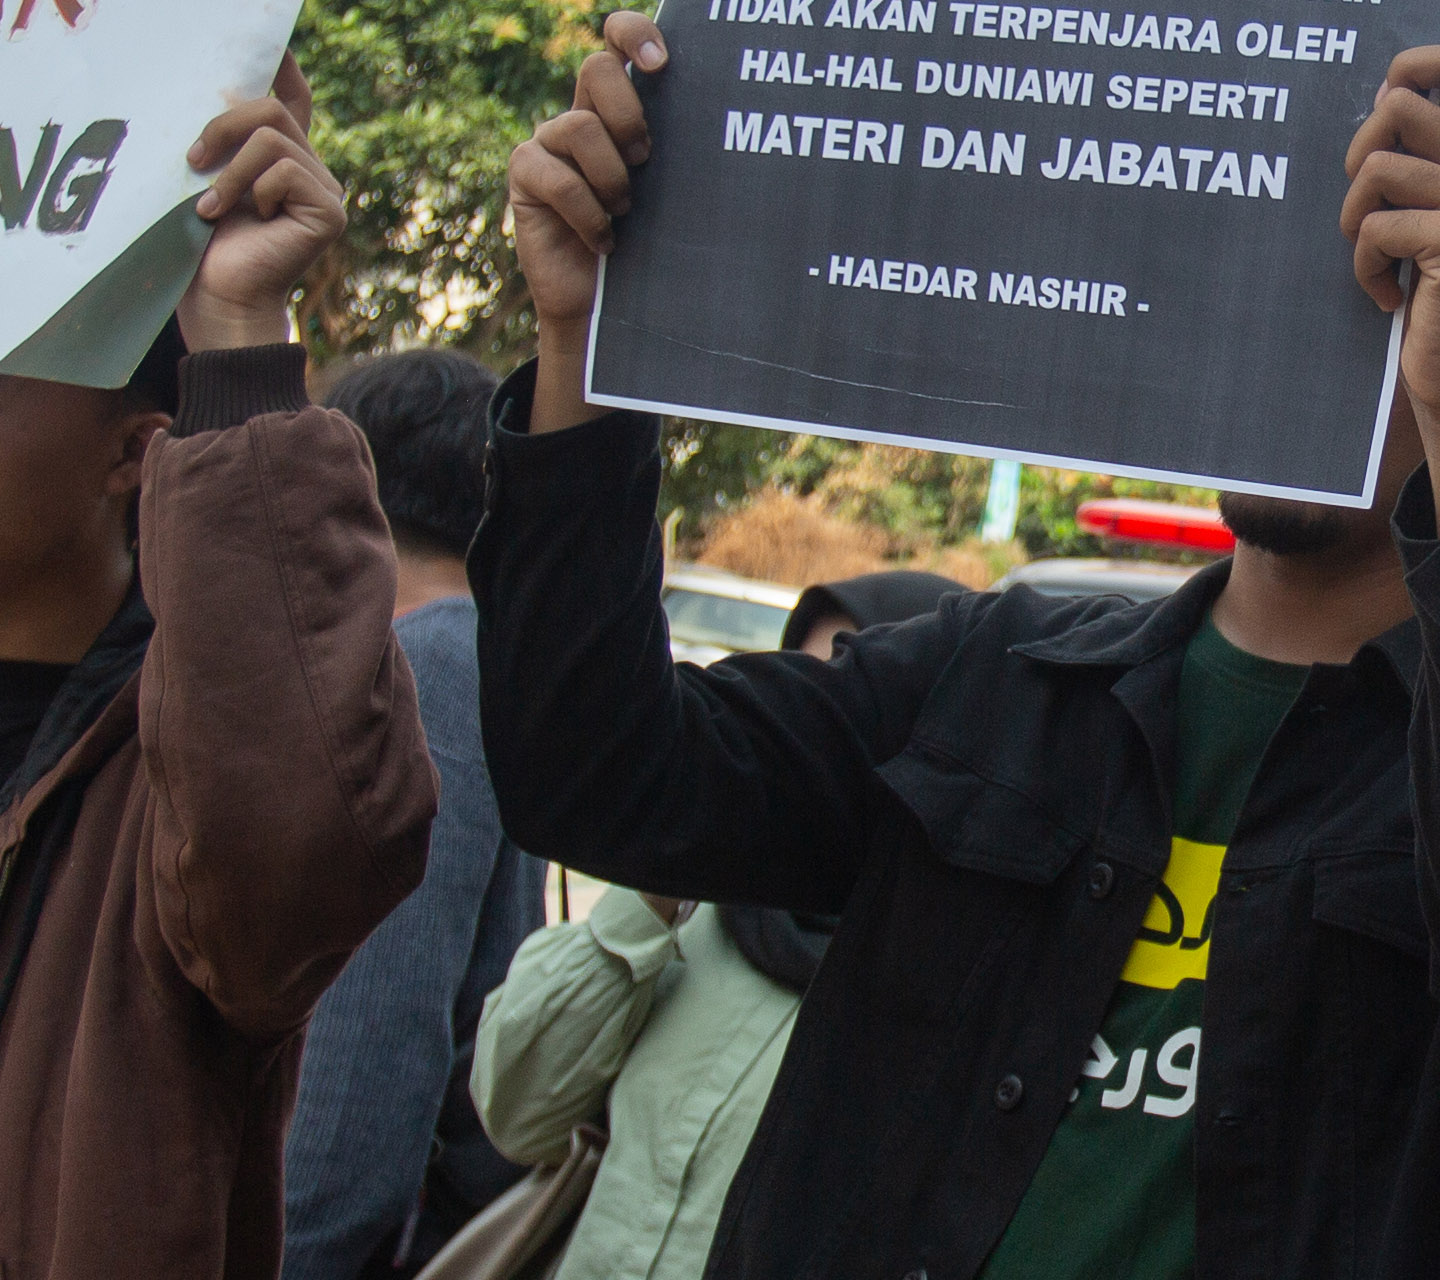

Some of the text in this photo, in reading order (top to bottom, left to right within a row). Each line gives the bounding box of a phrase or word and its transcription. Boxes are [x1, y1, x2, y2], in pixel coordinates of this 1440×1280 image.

[950, 3, 1221, 53] TERPENJARA
[1237, 23, 1357, 63] OLEH
[740, 49, 1289, 122] HAL-HAL DUNIAWI SEPERTI
[724, 111, 1288, 199] MATERI DAN JABATAN
[829, 255, 977, 300] HAEDAR
[989, 272, 1126, 316] NASHIR
